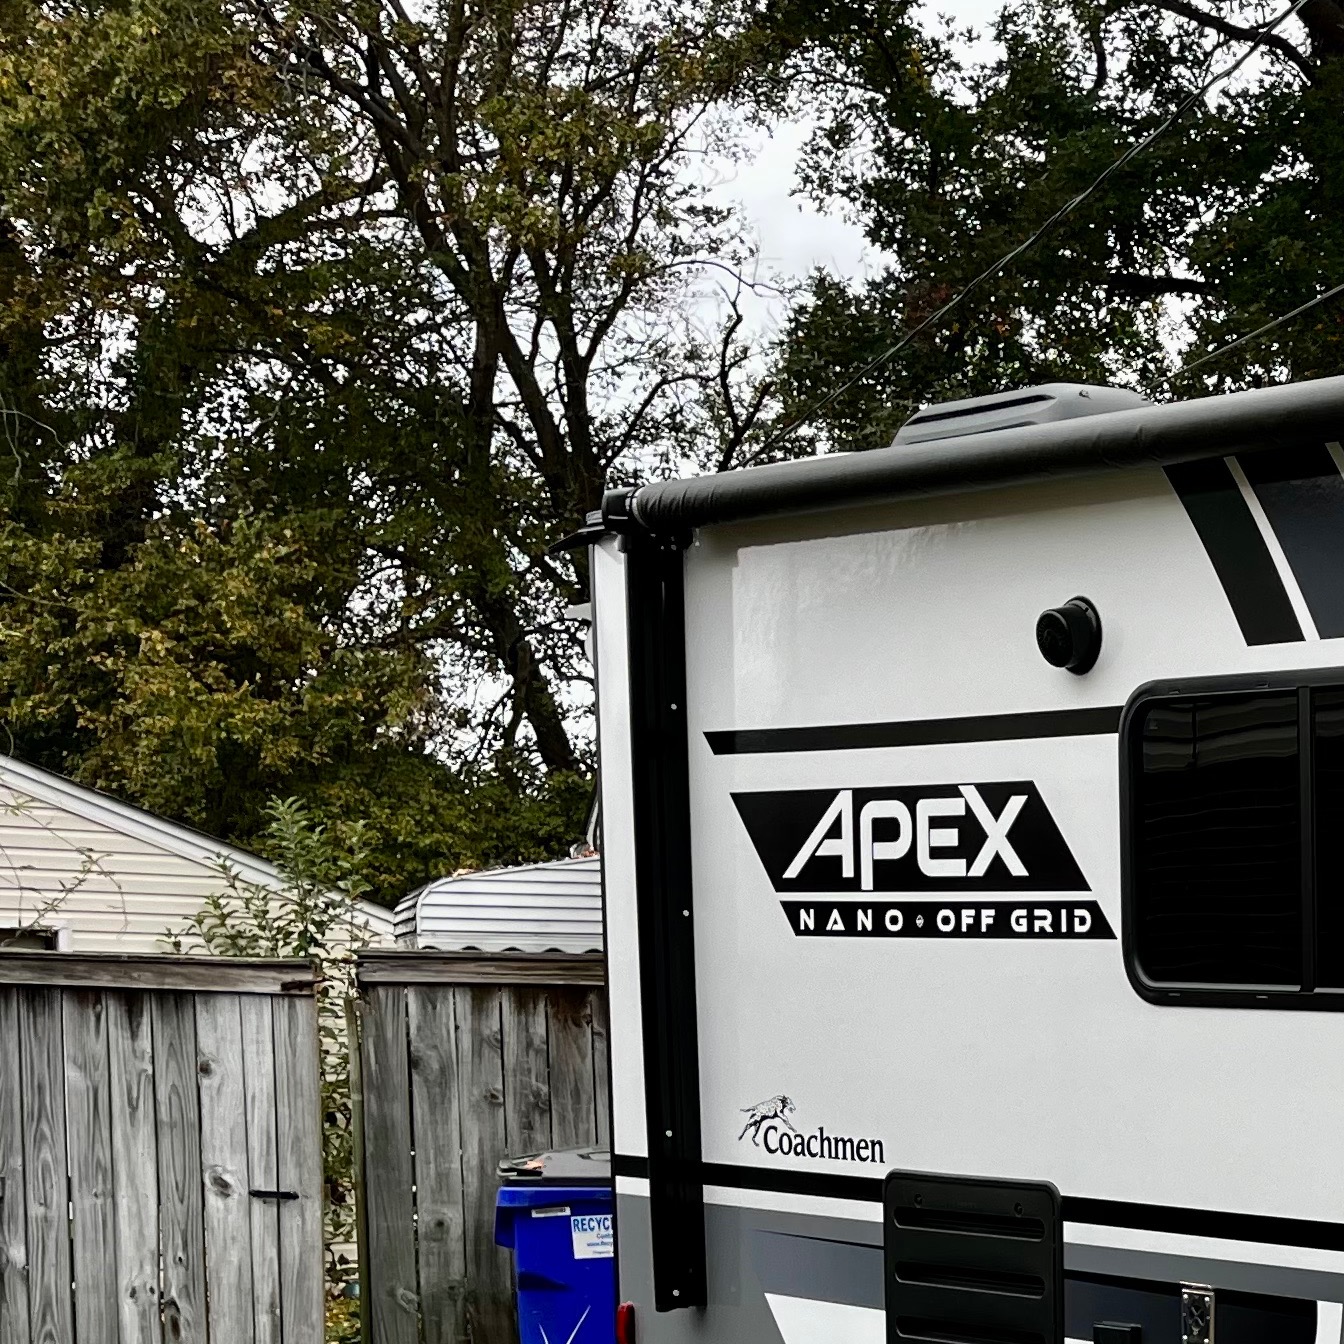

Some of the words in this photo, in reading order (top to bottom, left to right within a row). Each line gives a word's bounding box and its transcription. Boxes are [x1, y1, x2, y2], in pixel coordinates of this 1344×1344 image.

[781, 784, 1029, 891] APEX
[799, 909, 903, 931] NANO
[936, 909, 996, 933] OFF
[1010, 909, 1093, 934] GRID
[763, 1125, 886, 1164] Coachmen
[572, 1216, 612, 1232] RECYC
